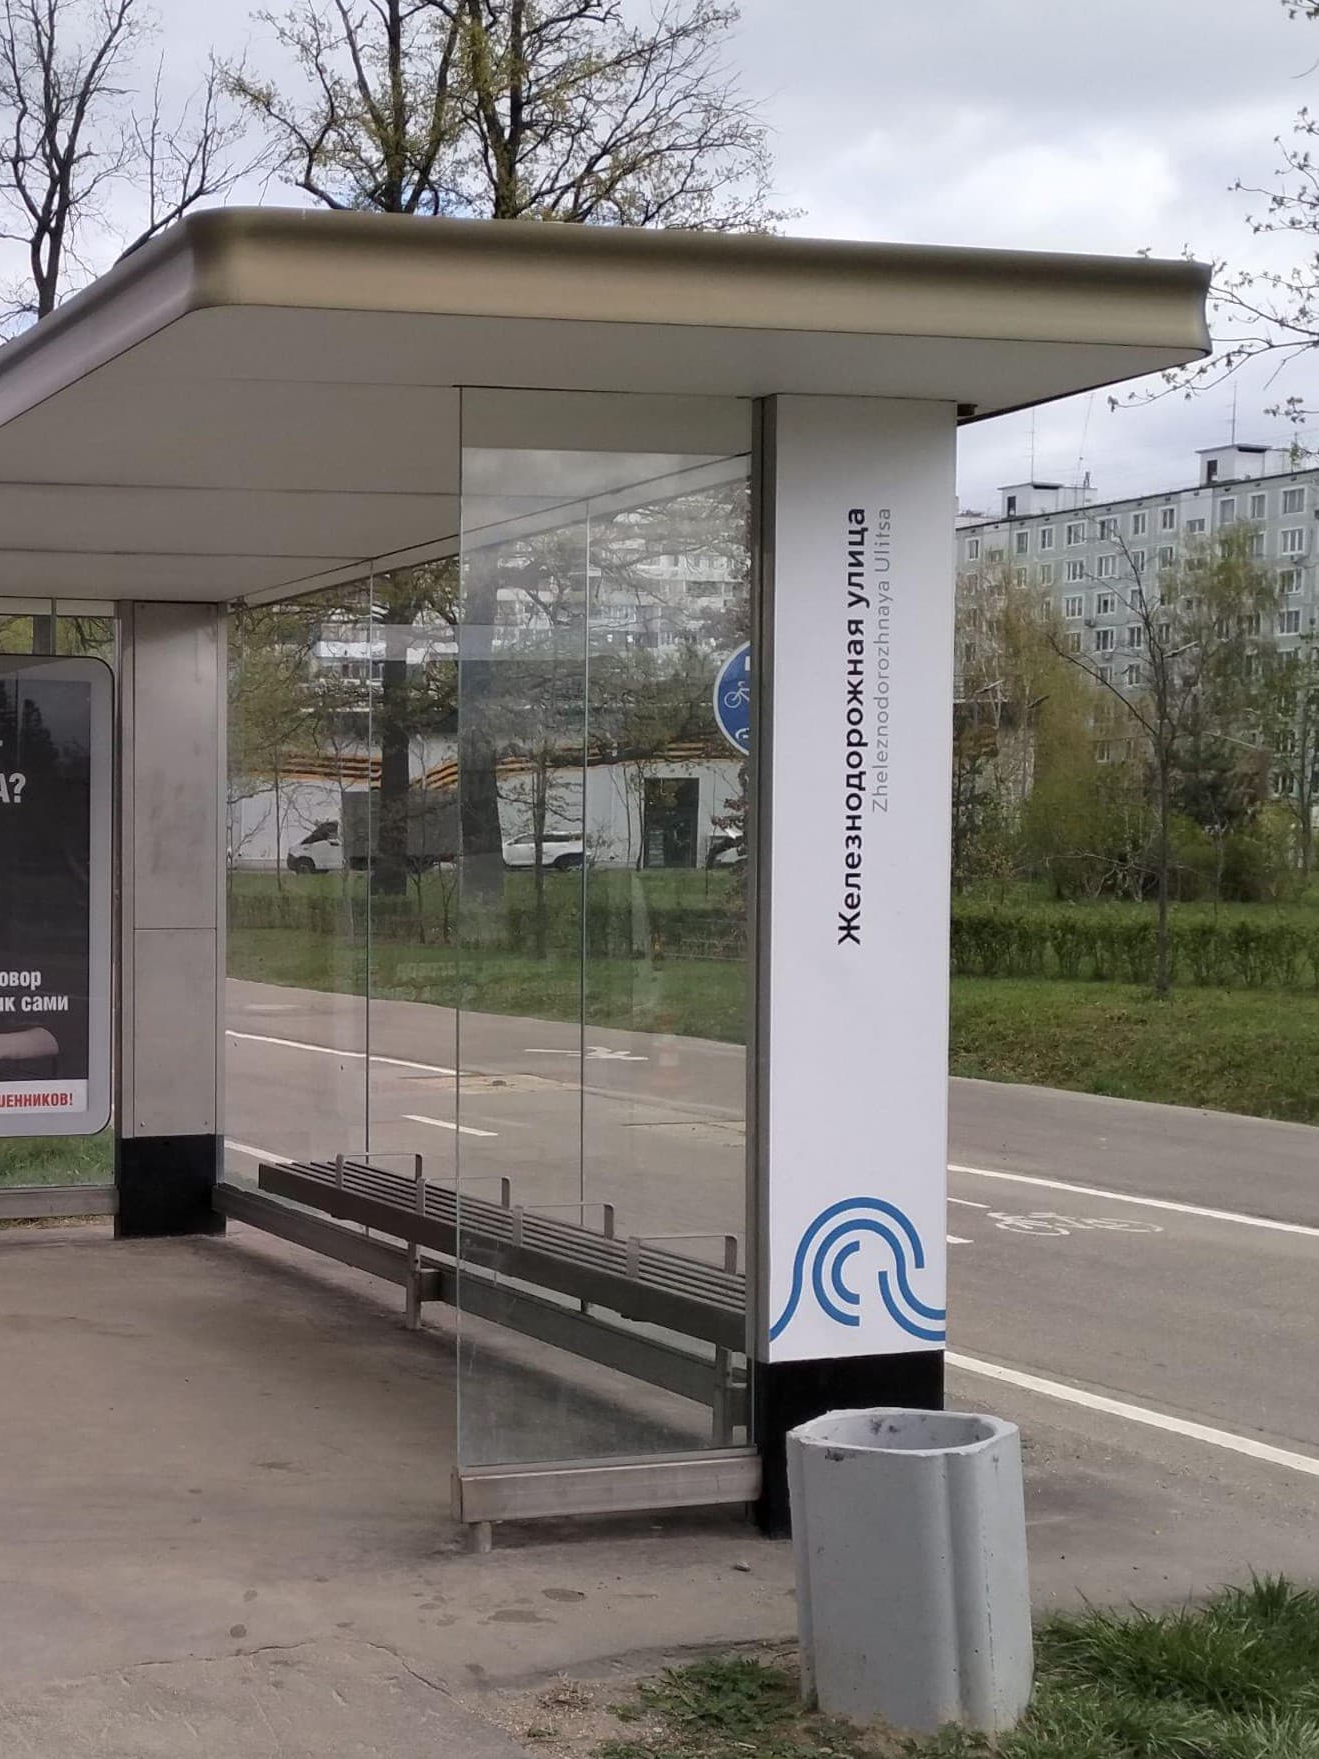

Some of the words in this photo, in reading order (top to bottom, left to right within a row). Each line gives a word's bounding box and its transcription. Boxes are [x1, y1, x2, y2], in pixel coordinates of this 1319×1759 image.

[847, 508, 869, 608] улица
[874, 508, 891, 571] Ulitsa
[872, 580, 893, 812] Zheleznodorozhnaya
[837, 619, 868, 945] Железнодорожная
[21, 995, 69, 1011] сами
